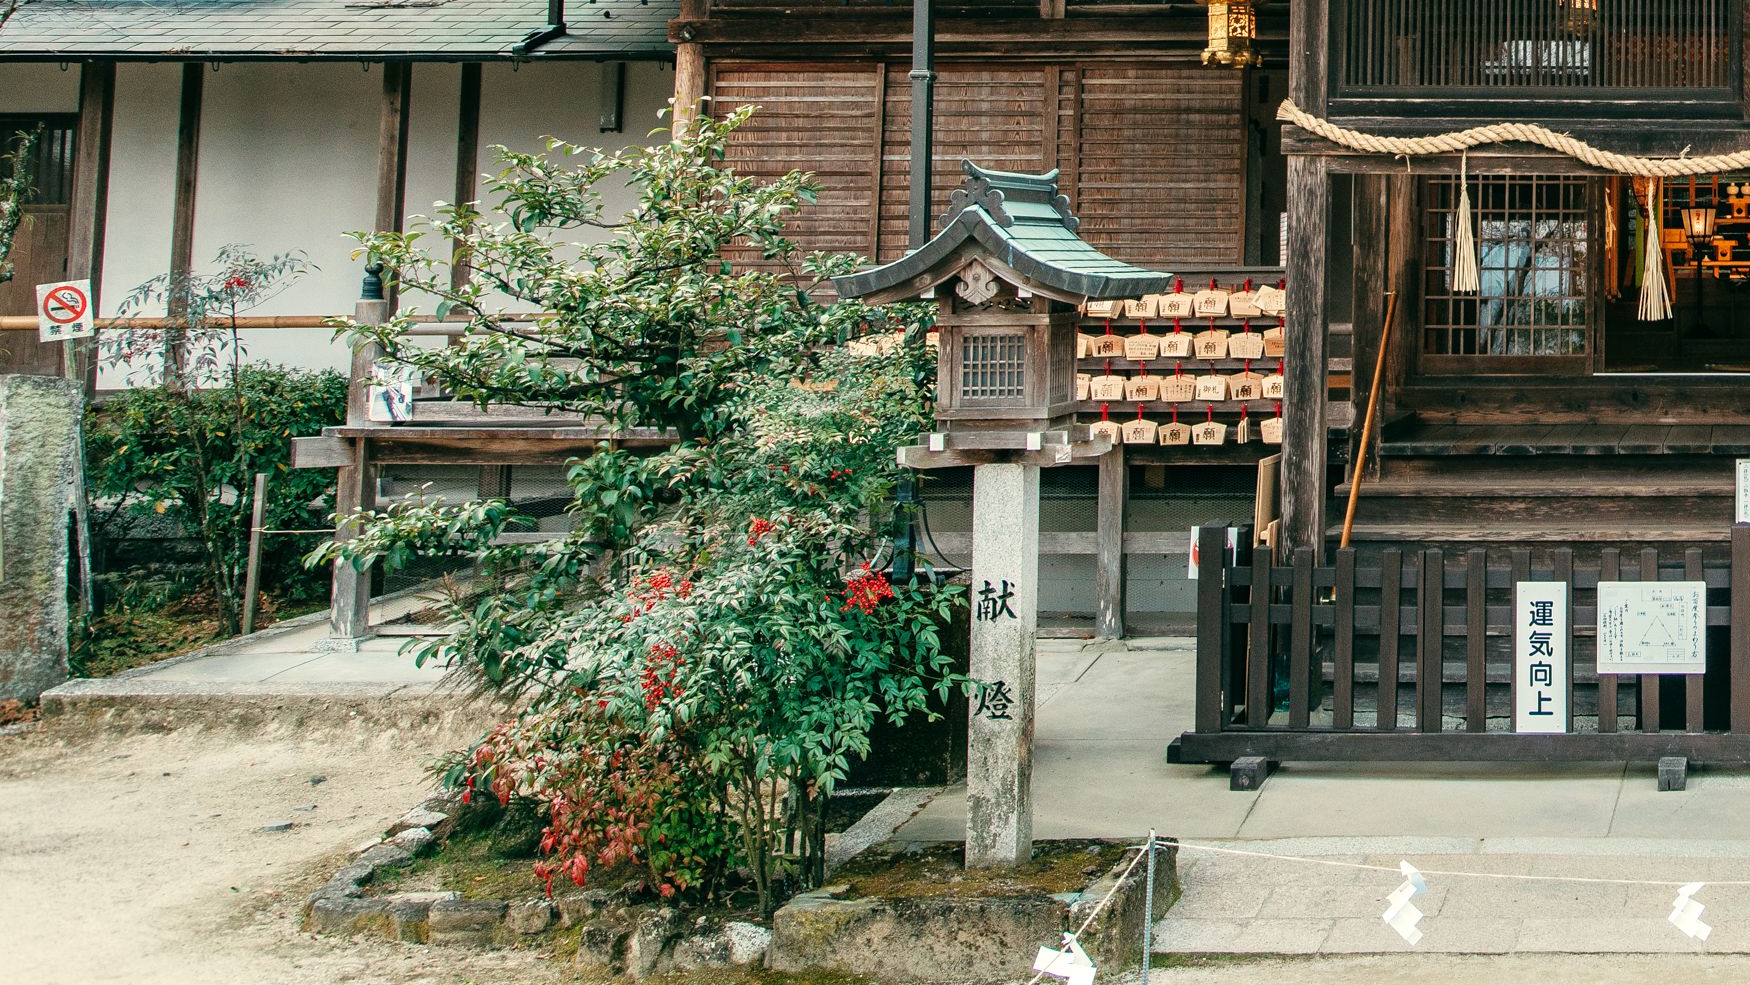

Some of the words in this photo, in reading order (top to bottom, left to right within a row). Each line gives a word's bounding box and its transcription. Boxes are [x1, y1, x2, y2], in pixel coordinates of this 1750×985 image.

[973, 579, 1018, 721] 献燈
[1528, 600, 1554, 716] 運気向上
